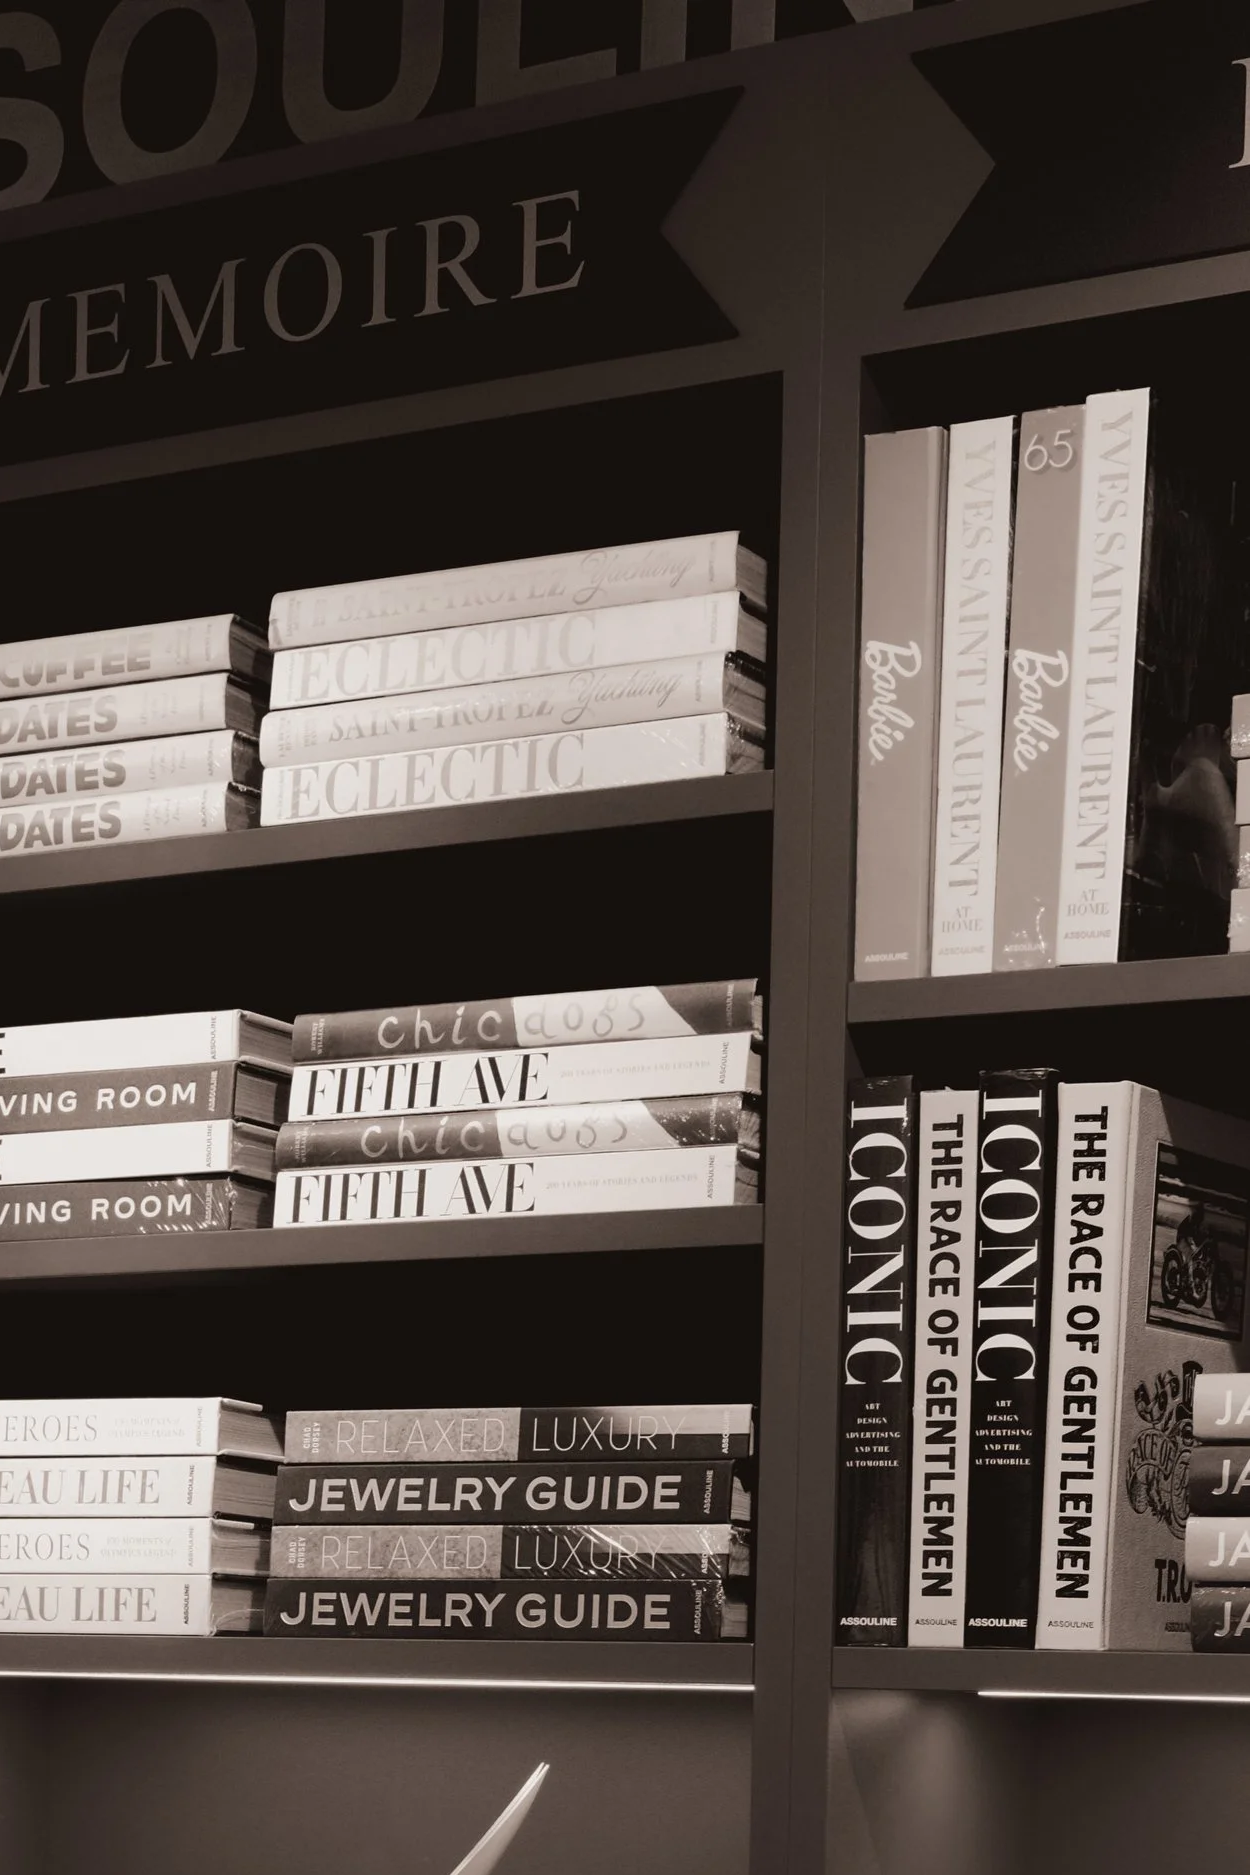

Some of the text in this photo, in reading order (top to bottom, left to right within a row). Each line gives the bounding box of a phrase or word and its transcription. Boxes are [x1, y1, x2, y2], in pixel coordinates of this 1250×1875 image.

[1023, 429, 1075, 472] 65
[295, 610, 598, 702] ECLECTIC
[948, 439, 997, 897] YVES SAINT LAURENT
[560, 670, 683, 726] Yachting
[864, 639, 922, 763] Barbie
[285, 732, 586, 820] ECLECTIC
[96, 1082, 197, 1110] ROOM
[303, 1051, 549, 1116] FIFTH AVE
[91, 1192, 192, 1221] ROOM
[845, 1097, 908, 1386] ICONIC
[974, 1089, 1043, 1383] ICONIC
[921, 1113, 965, 1597] THE RACE OF GENTLEMEN
[303, 1426, 312, 1448] CHAD
[312, 1421, 321, 1454] DORSEY
[336, 1415, 687, 1455] RELAXED LUXURY
[75, 1469, 161, 1505] LIFE
[288, 1474, 682, 1513] JEWELRY GUIDE
[702, 1469, 714, 1515] ASSOULINE
[70, 1585, 158, 1623] LIFE
[182, 1583, 191, 1625] ASSOULINE
[279, 1593, 671, 1629] JEWELRY GUIDE
[693, 1588, 703, 1635] ASSOULINE
[840, 1617, 897, 1626] ASSOULINE
[915, 1618, 957, 1626] ASSOULINE
[968, 1618, 1028, 1628] ASSOULINE
[1047, 1620, 1094, 1629] ASSOULINE
